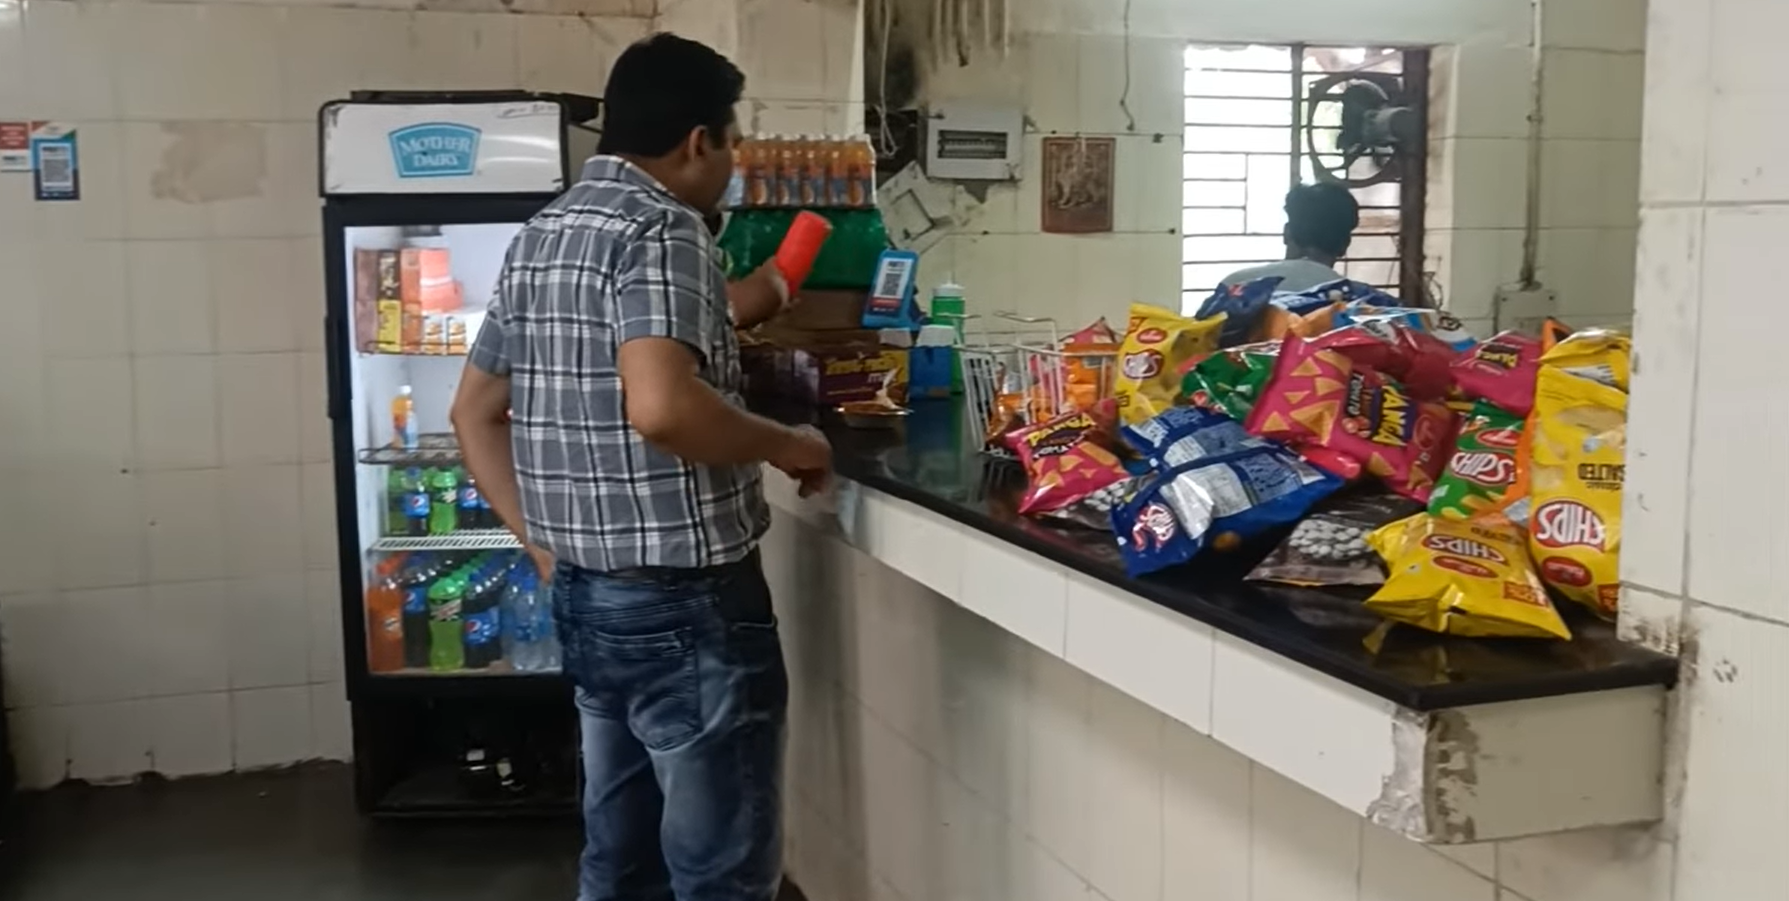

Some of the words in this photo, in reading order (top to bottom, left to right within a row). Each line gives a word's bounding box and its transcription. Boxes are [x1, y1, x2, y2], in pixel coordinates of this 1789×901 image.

[399, 136, 470, 155] MOTHER
[413, 153, 459, 167] DAIRY
[1450, 451, 1515, 483] CHIPS
[1535, 505, 1604, 545] CHIPS
[1428, 535, 1506, 563] CHIPS
